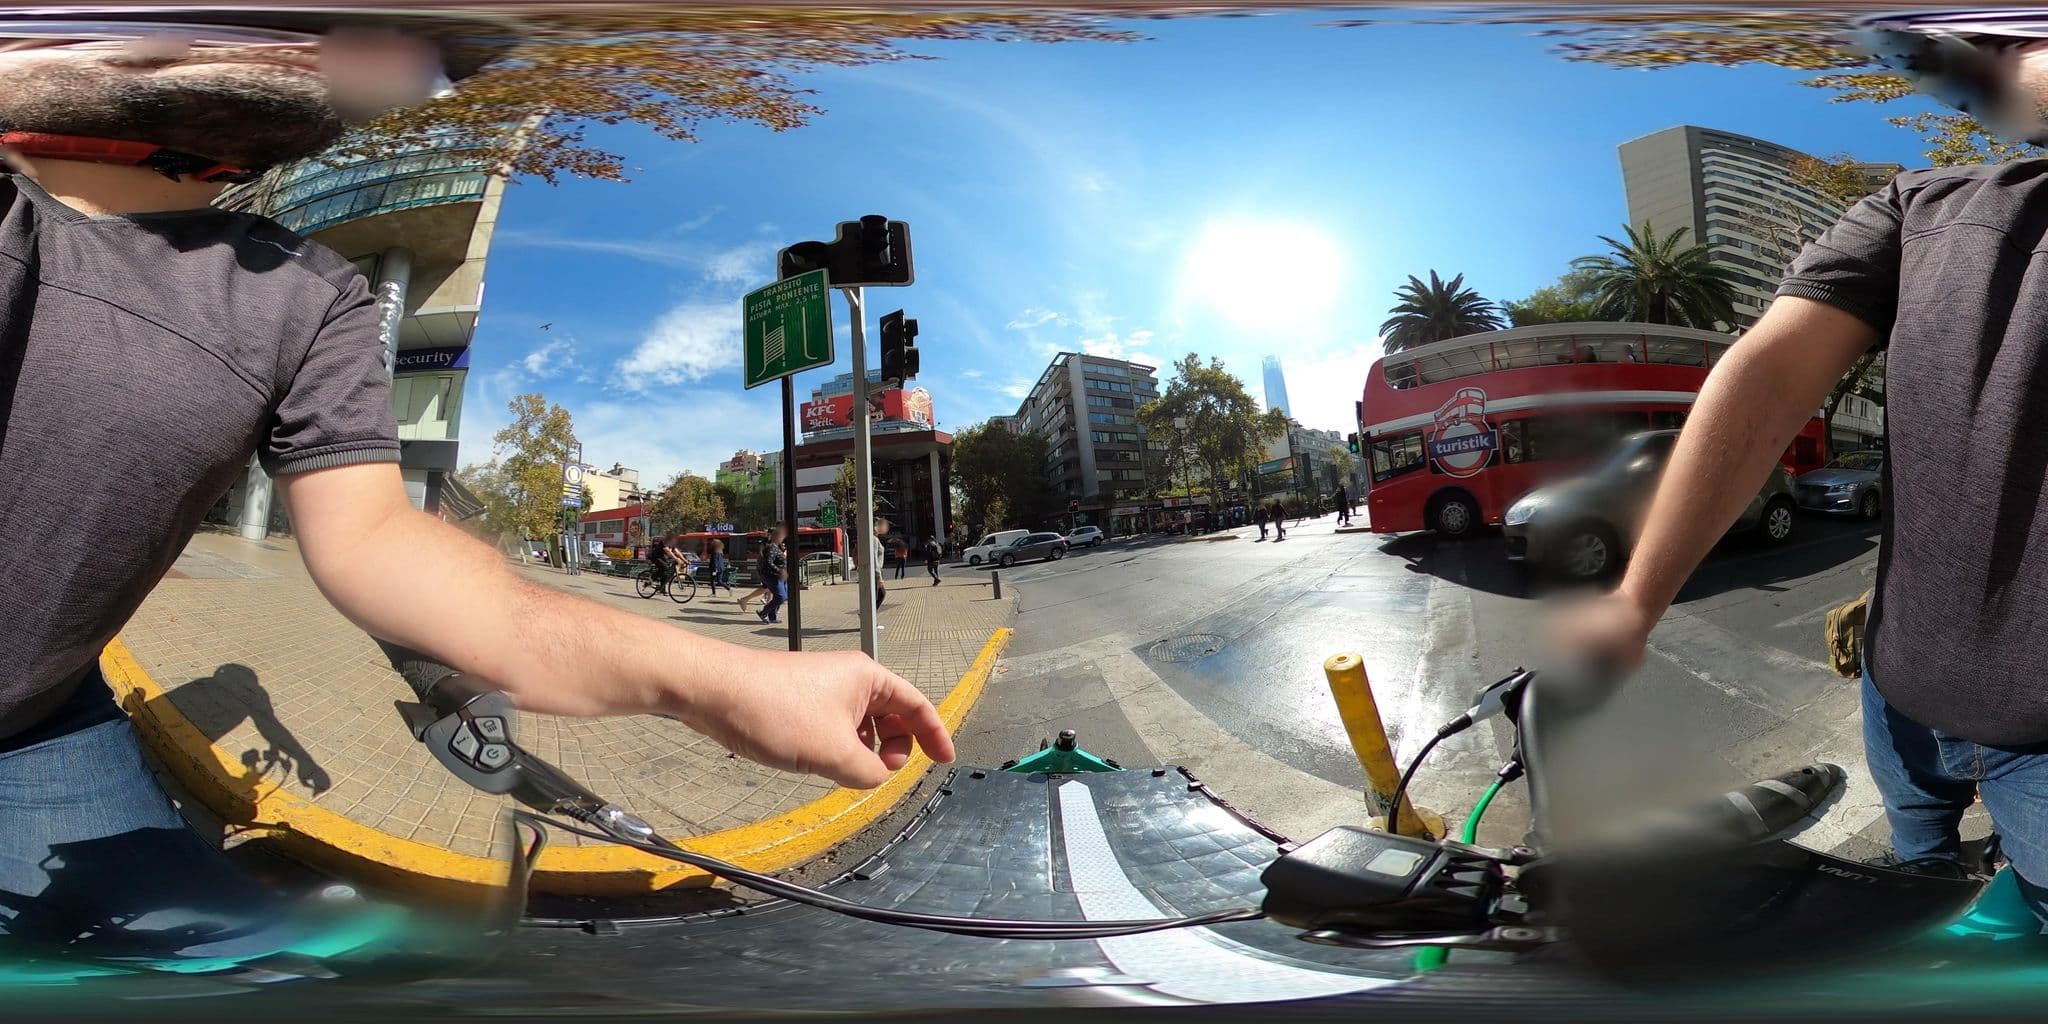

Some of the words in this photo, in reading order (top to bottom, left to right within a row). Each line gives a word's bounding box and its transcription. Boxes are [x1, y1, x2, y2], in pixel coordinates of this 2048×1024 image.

[763, 279, 801, 298] TRANSITO
[750, 299, 772, 313] PISTA
[776, 283, 820, 302] PONIENTE
[749, 308, 772, 322] ALTURA
[394, 352, 454, 366] security
[806, 403, 836, 418] KFC
[1436, 435, 1489, 454] turistik
